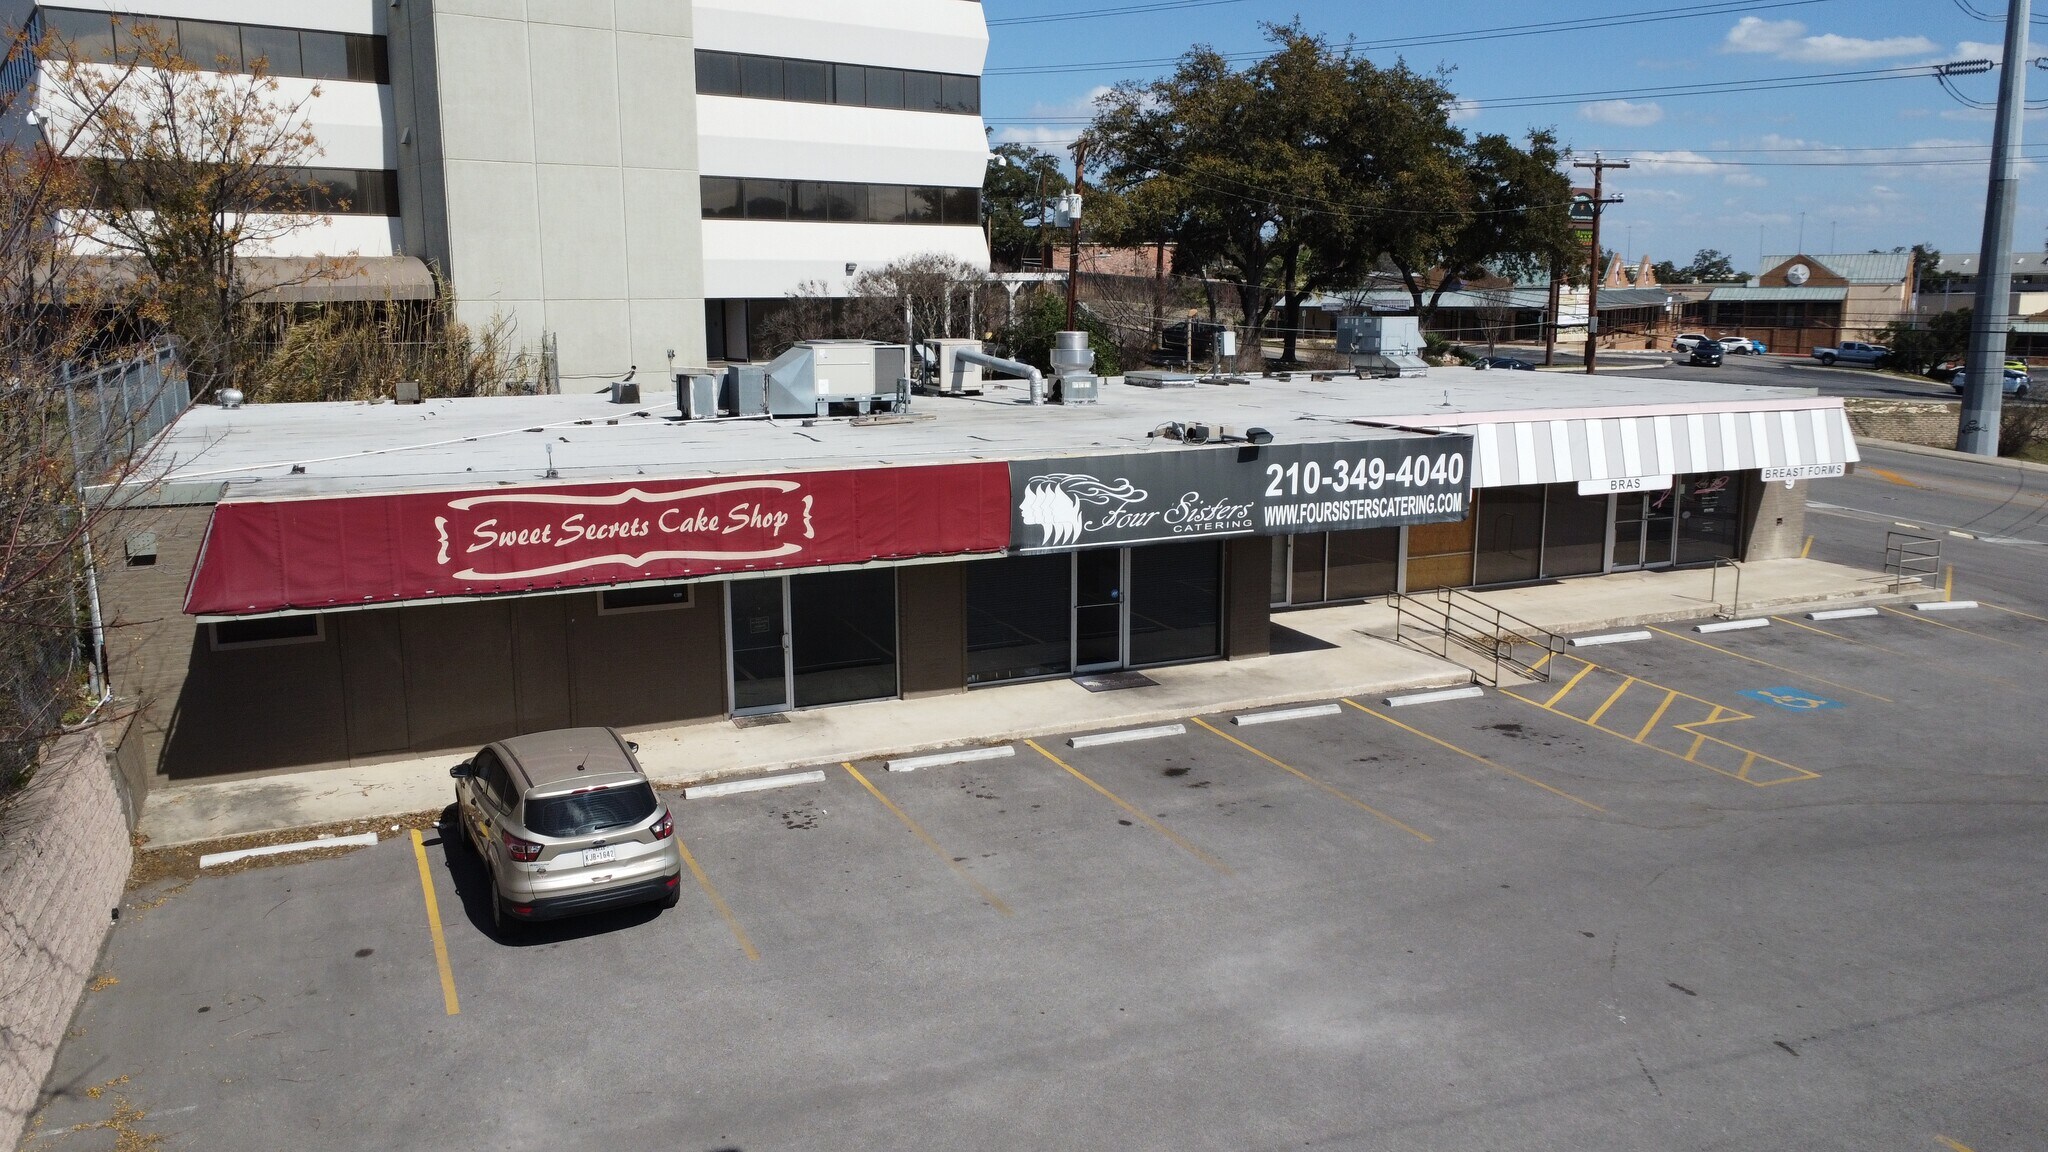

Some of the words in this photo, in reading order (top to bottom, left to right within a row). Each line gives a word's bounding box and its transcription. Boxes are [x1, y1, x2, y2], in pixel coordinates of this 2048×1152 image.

[1264, 452, 1464, 497] 210-349-4040
[1610, 478, 1641, 491] BRAS
[1764, 466, 1805, 479] BREAST
[1807, 464, 1843, 476] FORMS
[1083, 501, 1160, 532] Four
[1163, 491, 1254, 525] Sisters
[1173, 519, 1253, 534] CATERING
[1263, 492, 1463, 527] WWW.FOURSISTERSCATERING.COM
[466, 518, 552, 554] Sweet
[554, 513, 650, 548] Secrets
[658, 506, 720, 533] Cake
[721, 502, 789, 537] Shop
